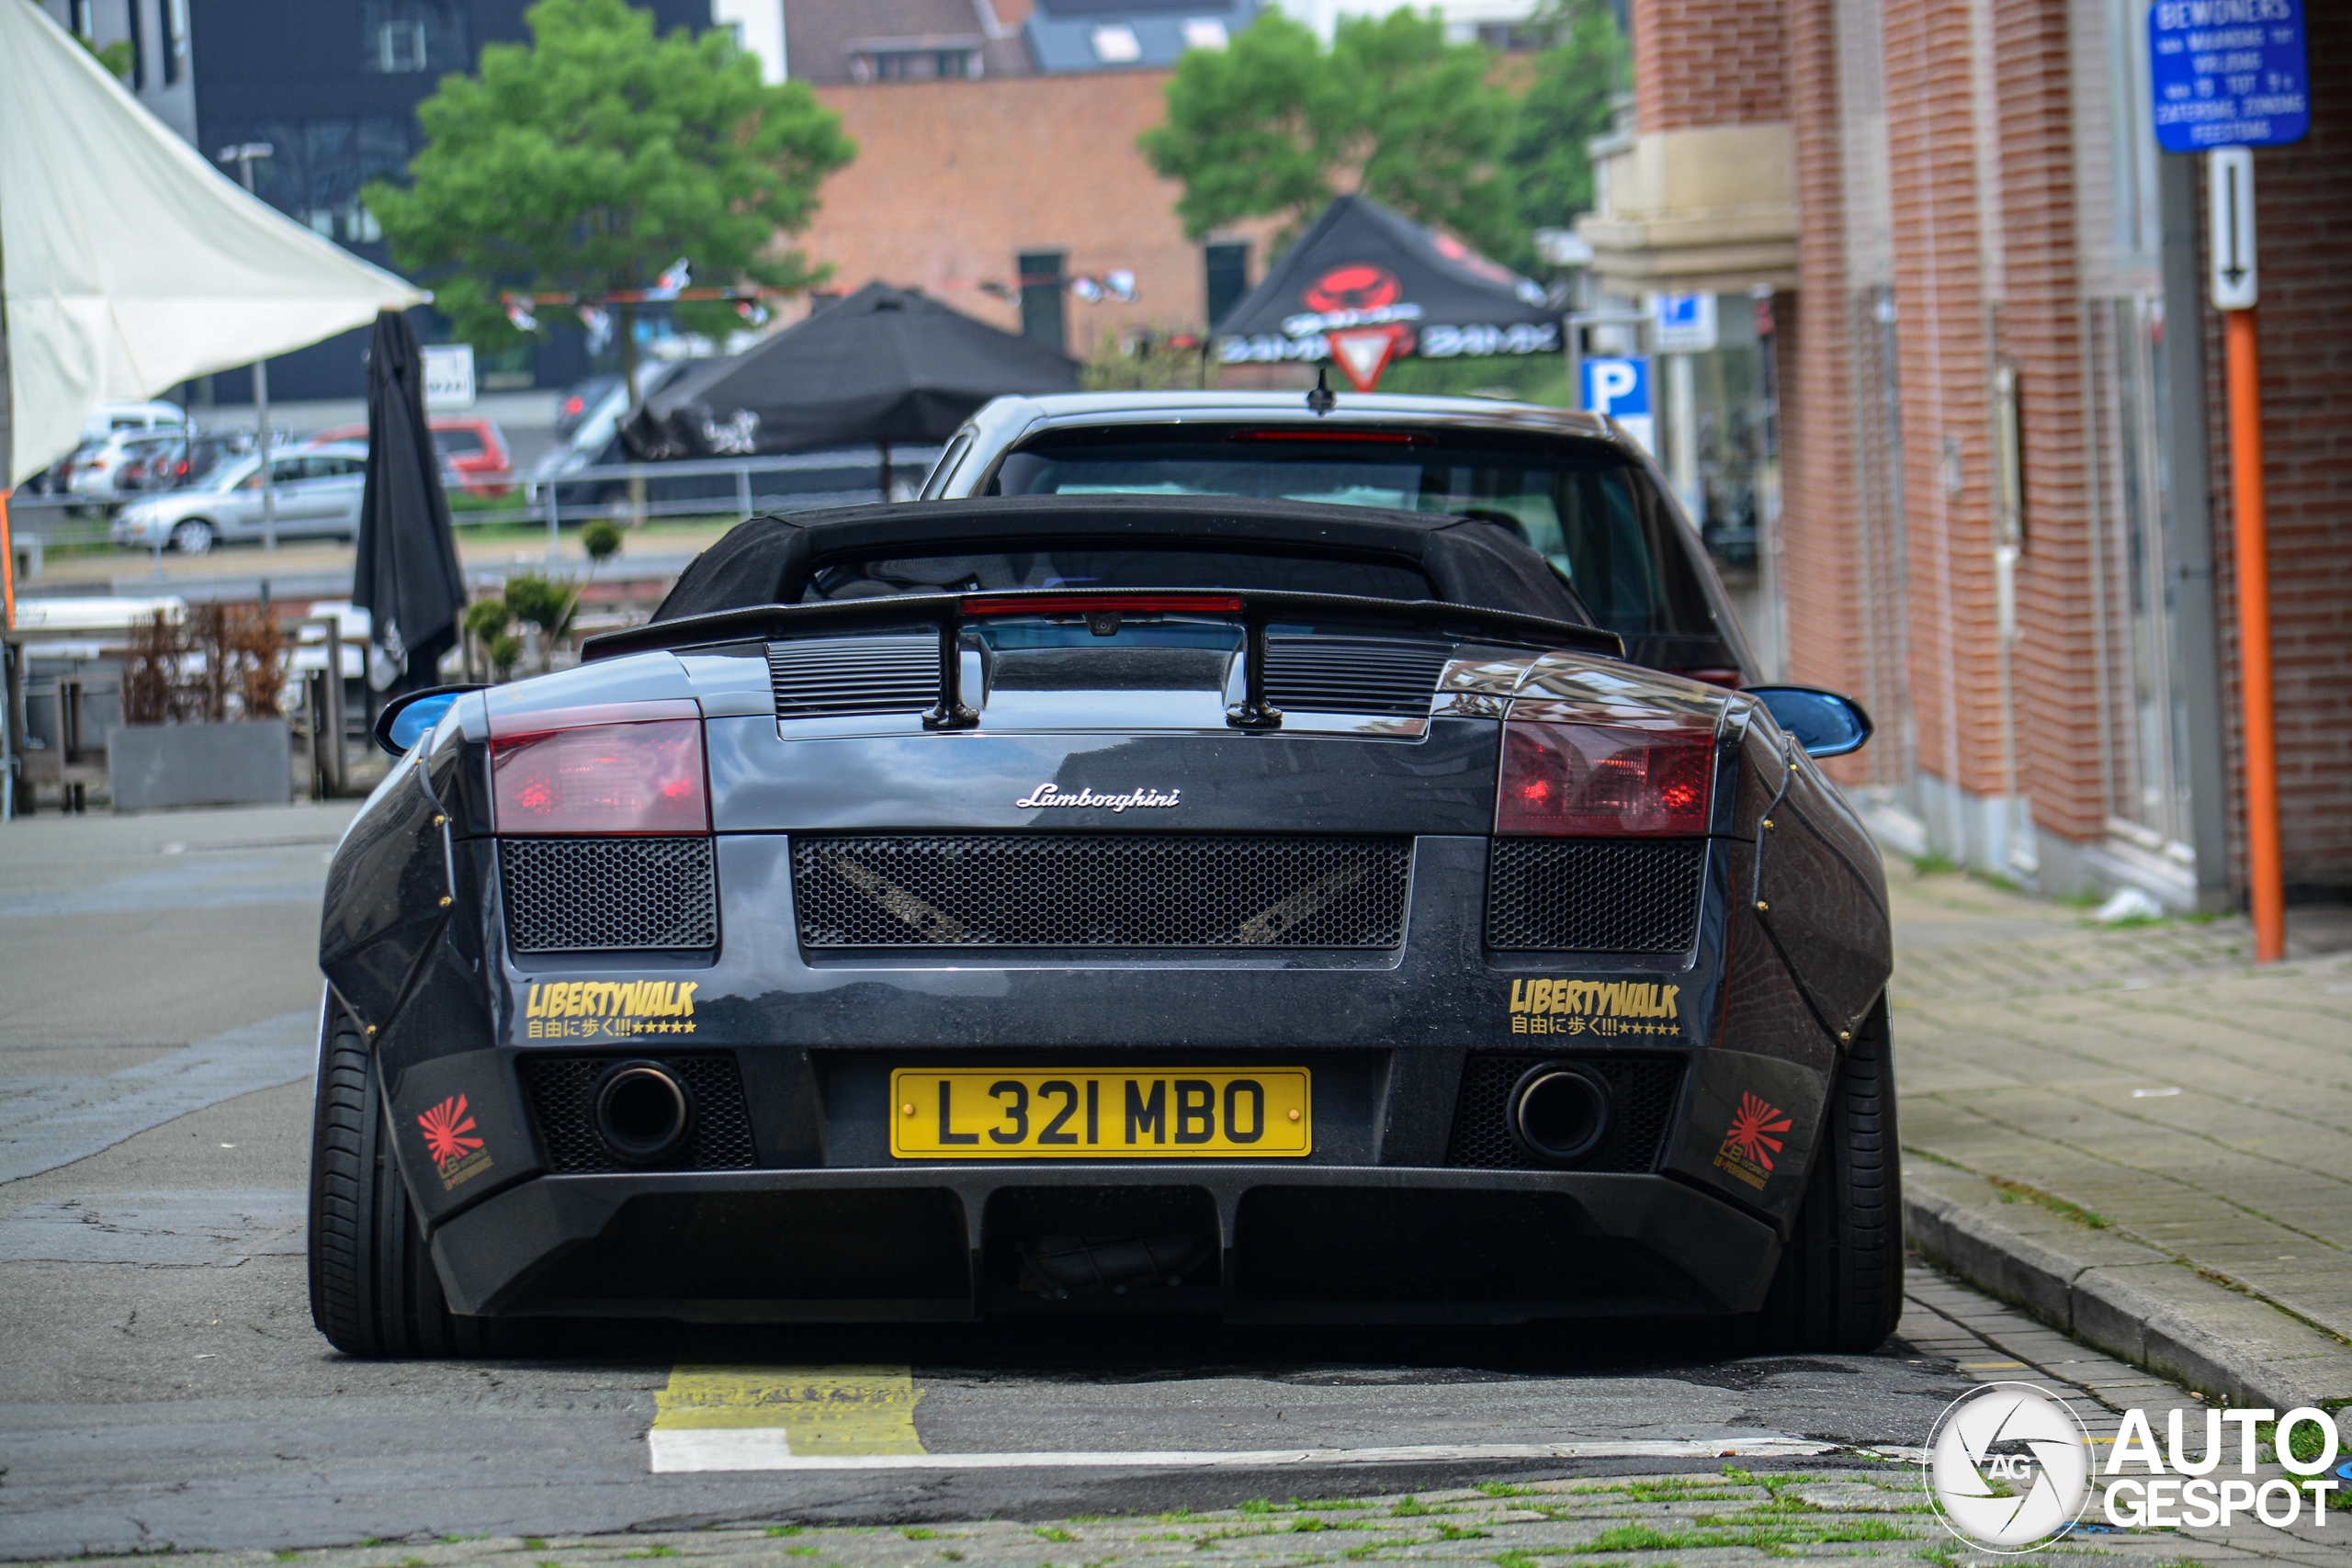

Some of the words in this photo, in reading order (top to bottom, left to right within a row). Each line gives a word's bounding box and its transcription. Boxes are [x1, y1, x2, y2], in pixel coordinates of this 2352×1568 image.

[1591, 358, 1637, 414] P
[1016, 783, 1181, 812] Lamborghini
[526, 980, 698, 1018] LIBERTYWALK
[1510, 979, 1680, 1019] LIBERTYWALK
[938, 1079, 1099, 1145] L321
[1125, 1079, 1265, 1145] MBO
